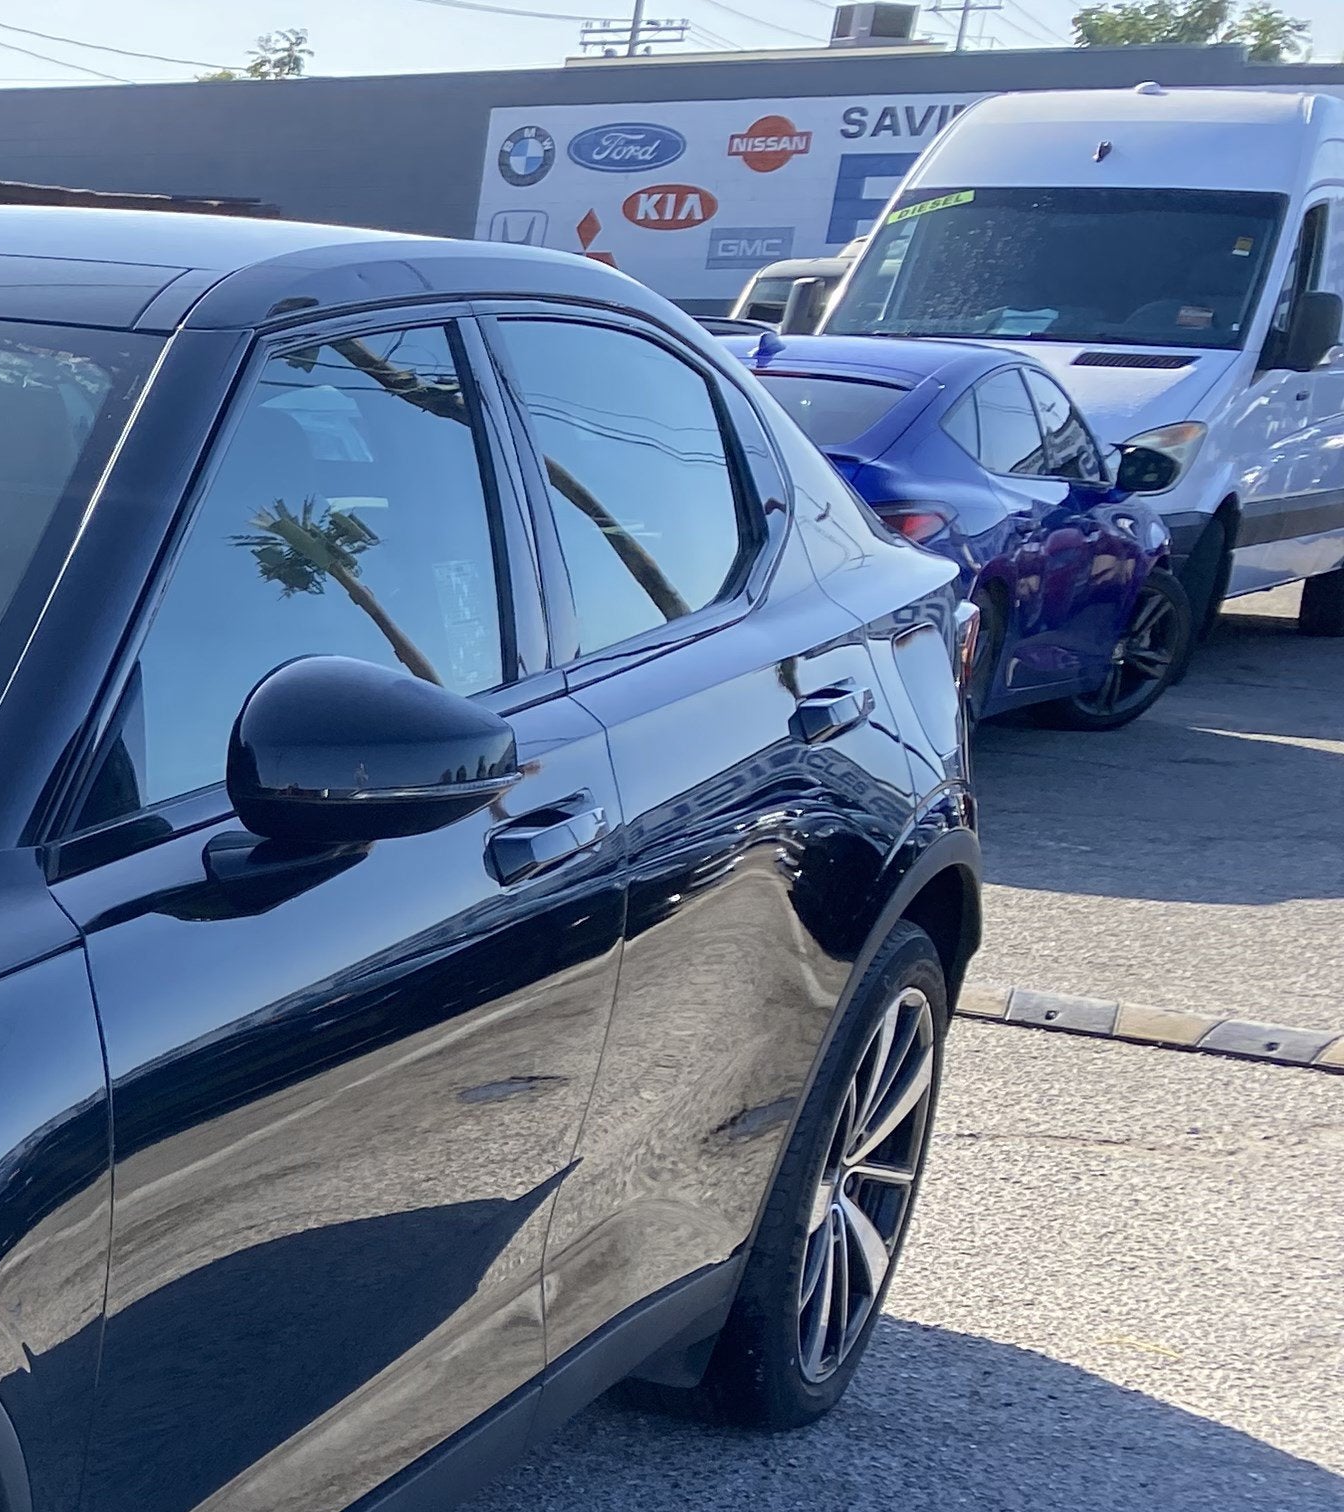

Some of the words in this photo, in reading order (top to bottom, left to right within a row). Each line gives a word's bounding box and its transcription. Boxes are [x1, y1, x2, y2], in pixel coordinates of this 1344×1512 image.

[840, 104, 968, 139] SAVI
[592, 132, 662, 161] Ford
[731, 135, 808, 153] NISSAN
[636, 193, 704, 221] KIA
[896, 193, 964, 219] DIESEL
[718, 239, 782, 257] GMC
